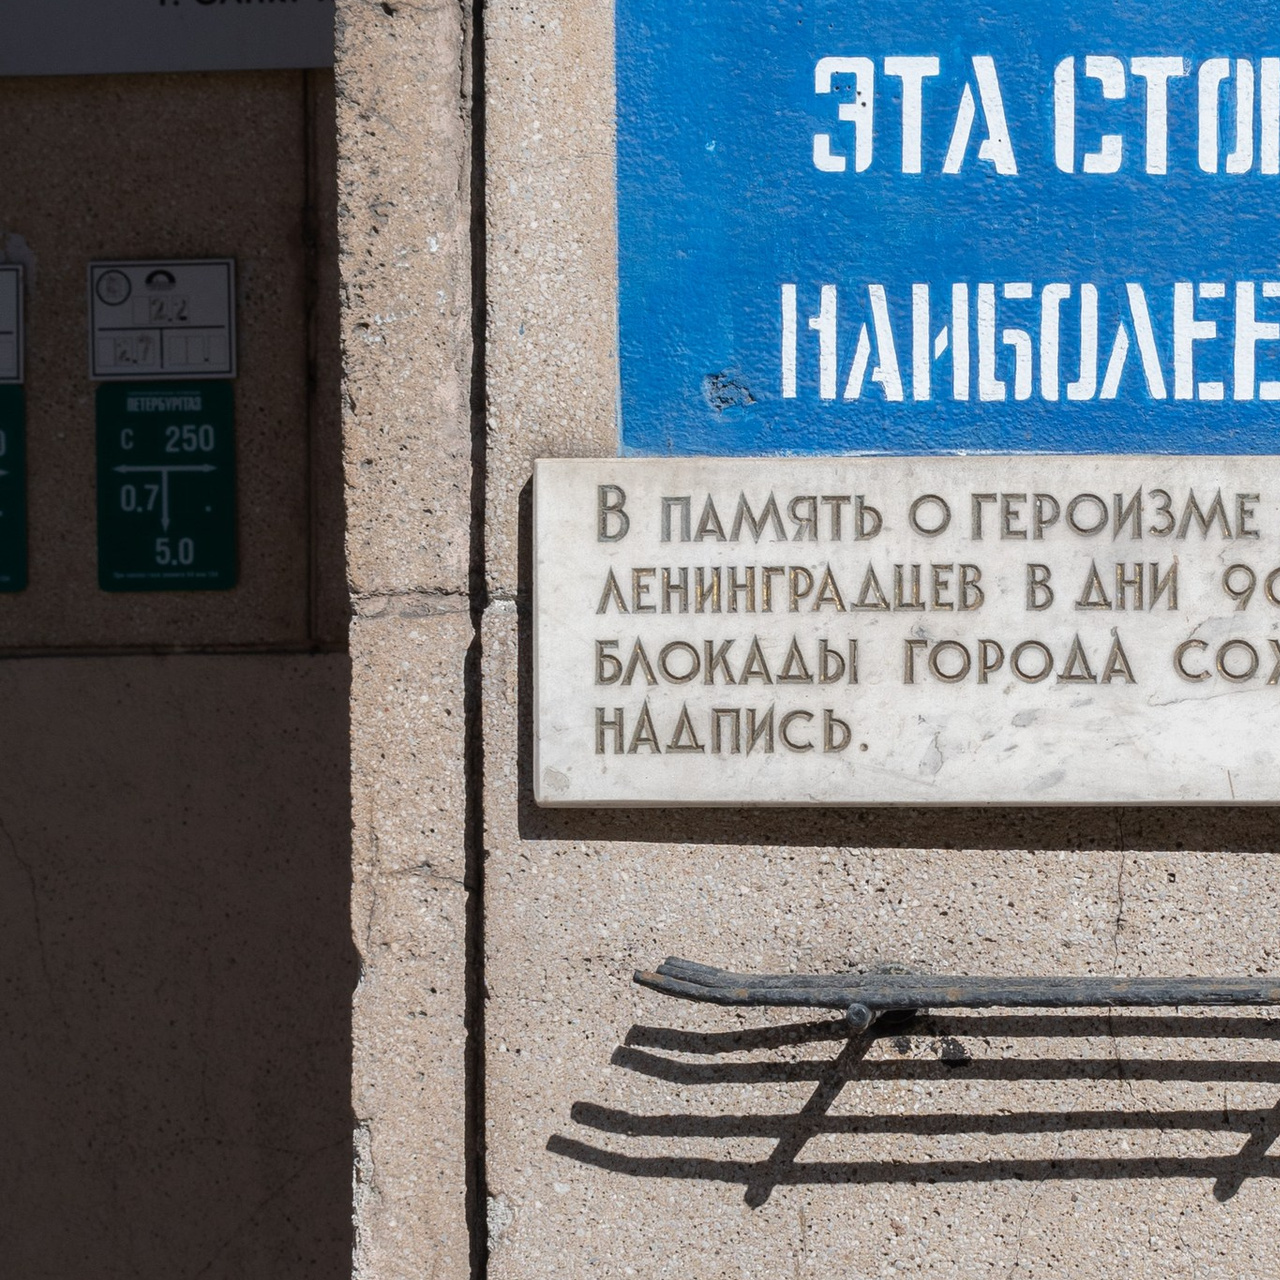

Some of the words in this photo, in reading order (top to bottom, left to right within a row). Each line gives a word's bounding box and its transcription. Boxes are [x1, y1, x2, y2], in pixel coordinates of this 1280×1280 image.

[813, 56, 1018, 175] ЭТА
[165, 424, 215, 453] 250
[120, 484, 160, 513] 0.7
[597, 484, 630, 542] В
[661, 491, 883, 544] ПАМЯТЬ
[908, 494, 951, 538] О
[971, 485, 1260, 541] ГЕРОИЗМЕ
[155, 537, 195, 566] 5.0
[596, 562, 985, 614] ЛЕНИНГРАДЦЕВ
[1026, 563, 1054, 612] В
[1075, 559, 1178, 611] ДНИ
[595, 635, 858, 686] БЛОКАДЫ
[904, 627, 1137, 684] ГОРОДА
[595, 699, 868, 757] НАДПИСЬ.
